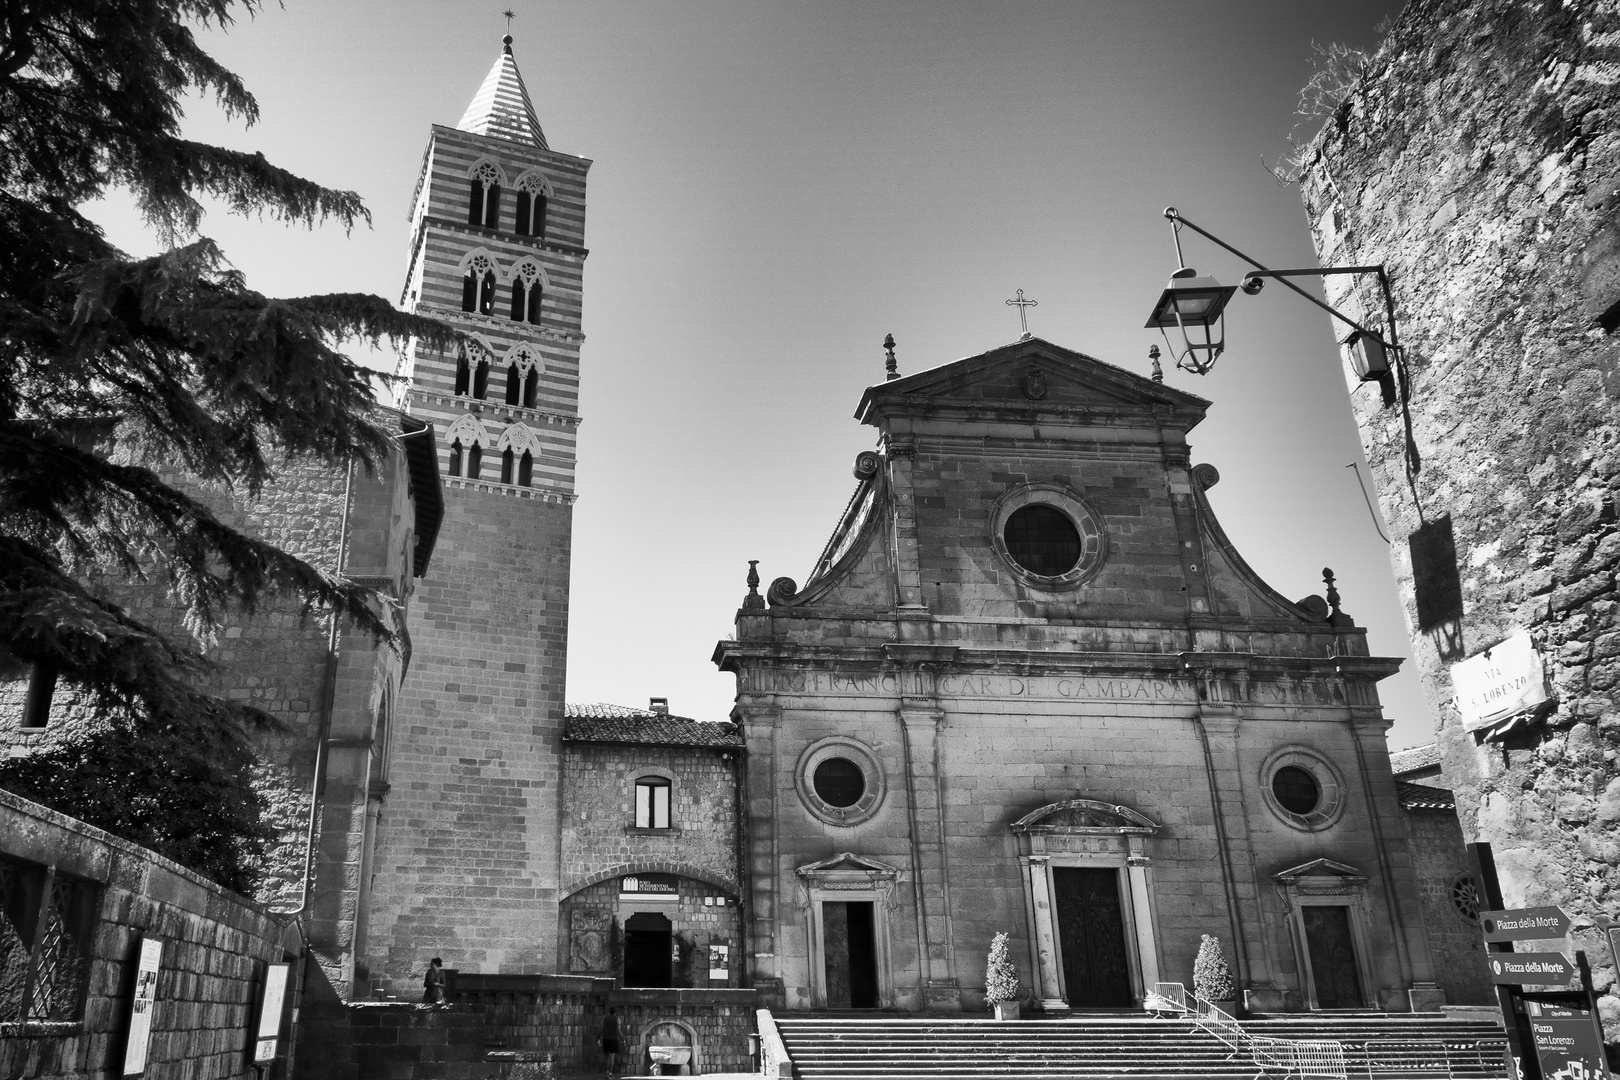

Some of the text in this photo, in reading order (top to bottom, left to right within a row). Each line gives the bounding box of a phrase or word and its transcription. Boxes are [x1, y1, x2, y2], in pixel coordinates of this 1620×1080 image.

[1484, 668, 1502, 679] VIA
[942, 677, 994, 695] CAR
[1008, 678, 1040, 697] DE
[1056, 679, 1188, 700] GAMBARA
[1483, 676, 1527, 704] LORENZO
[1496, 916, 1560, 930] Piazza della Morte
[1504, 962, 1564, 973] Piazza della Morte
[1533, 1023, 1554, 1033] Piazza
[1536, 1035, 1575, 1045] San Lorenzo
